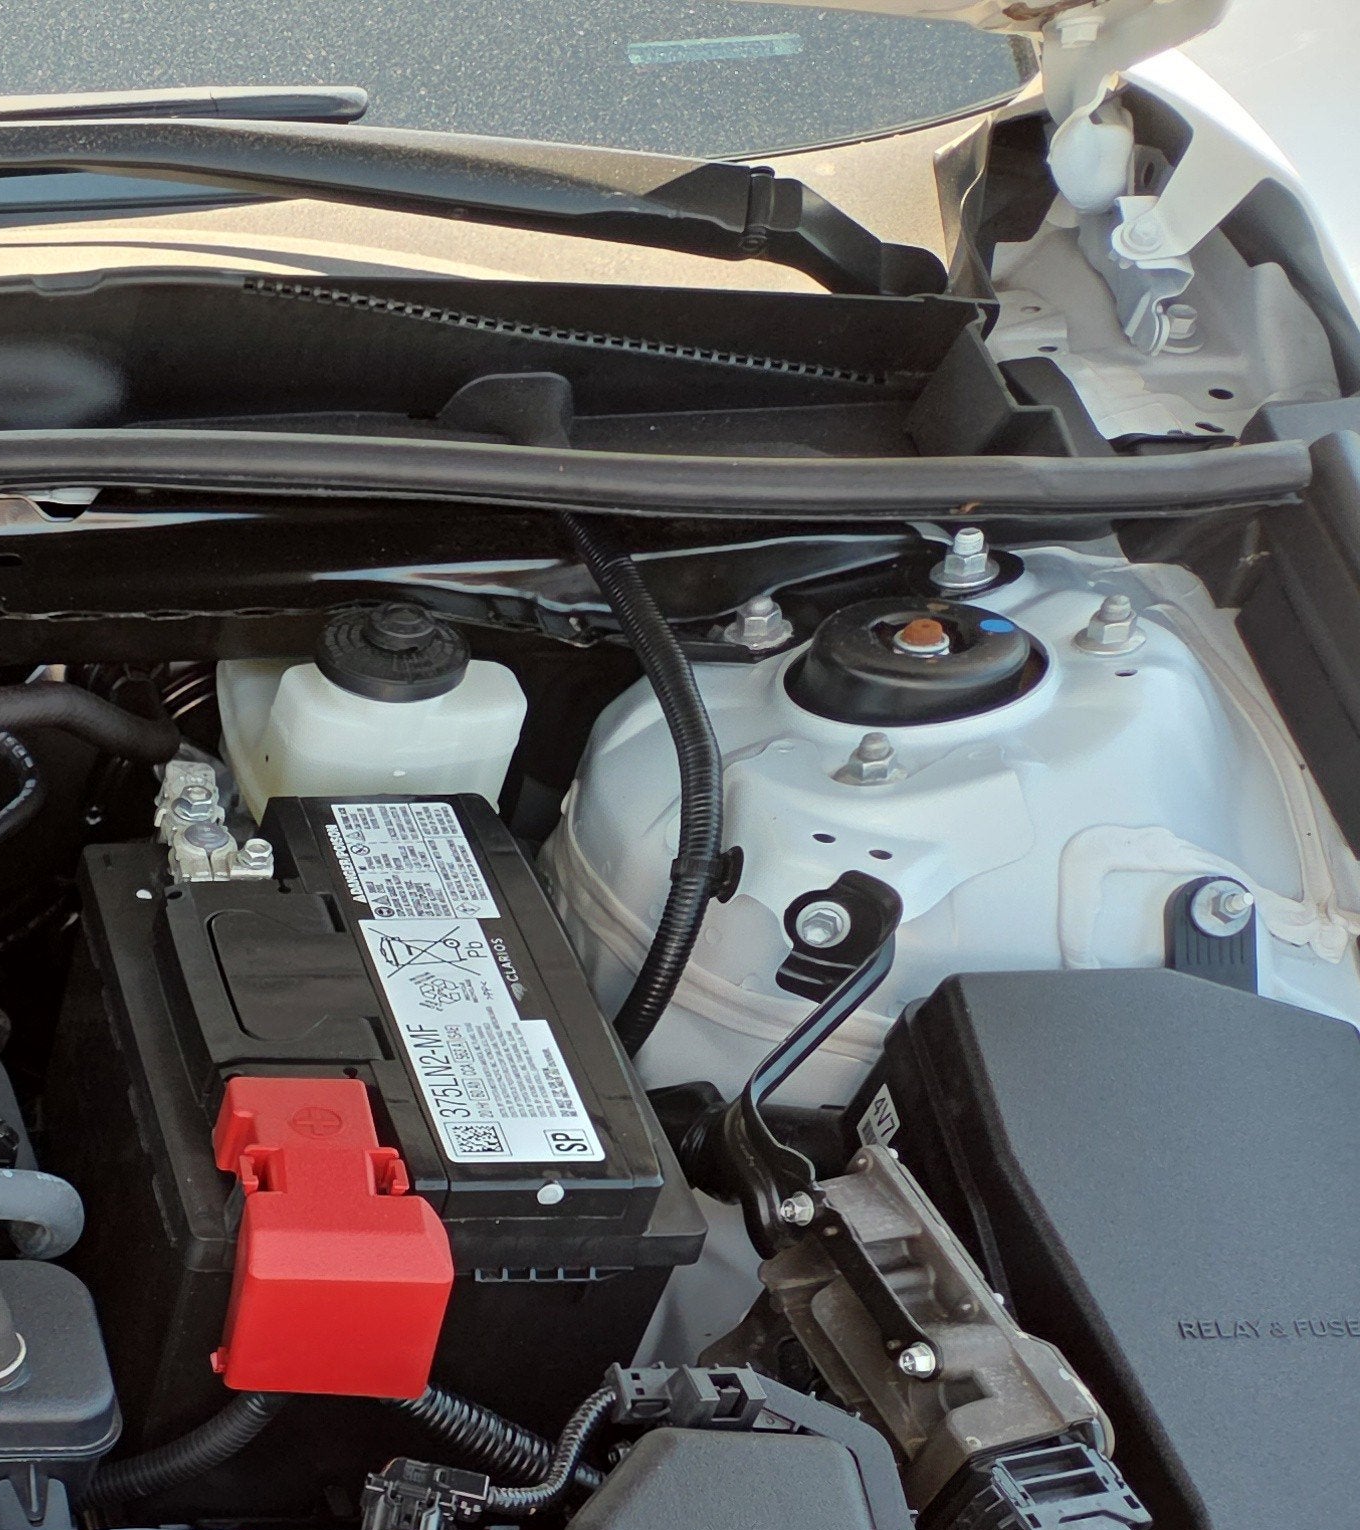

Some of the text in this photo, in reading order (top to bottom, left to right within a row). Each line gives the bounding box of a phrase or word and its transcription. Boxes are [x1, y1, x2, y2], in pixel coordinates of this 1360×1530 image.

[465, 941, 488, 958] Pb
[490, 937, 519, 982] CLARIOS
[406, 1024, 471, 1118] 375LN2-MF
[551, 1132, 588, 1152] SP
[1178, 1319, 1360, 1339] RELAY & FUSE
